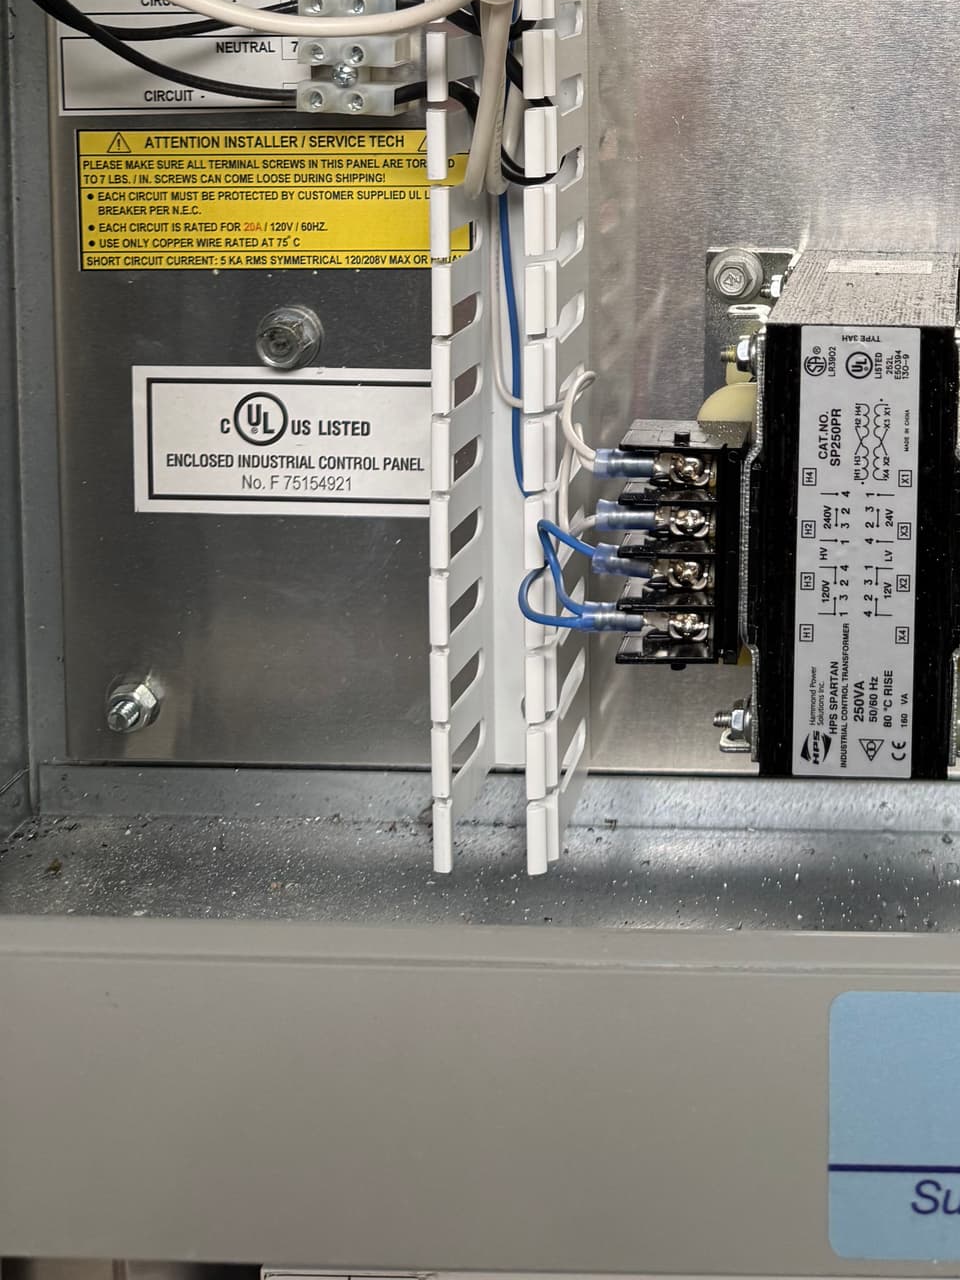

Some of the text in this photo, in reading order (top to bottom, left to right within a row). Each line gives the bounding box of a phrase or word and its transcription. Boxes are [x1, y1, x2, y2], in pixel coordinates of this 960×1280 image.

[216, 42, 275, 53] NEUTRAL
[144, 90, 194, 102] CIRCUIT
[144, 135, 405, 149] ATTENTION INSTALLER SERVICE TECH
[83, 159, 403, 170] PLEASE MAKE SURE ALL TERMINAL SCREWS THIS PANEL ARE
[108, 173, 386, 184] LBS. SCREWS CAN COME LOOSE DURING SHIPPING!
[98, 192, 125, 201] EACH
[128, 192, 168, 201] CIRCUIT
[171, 191, 199, 201] MUST
[218, 191, 279, 200] PROTECTED
[281, 191, 295, 200] BY
[297, 190, 353, 200] CUSTOMER
[357, 190, 406, 200] SUPPLIED
[409, 190, 422, 199] UL
[98, 206, 202, 215] BREAKER PER N.E.C.
[99, 222, 328, 232] EACH CIRCUIT RATED FOR 20A 120V 60HZ.
[100, 238, 275, 248] USE ONLY COPPER WIRE RATED AT
[86, 257, 121, 266] SHORT
[124, 257, 164, 266] CIRCUIT
[166, 257, 219, 266] CURRENT:
[229, 256, 242, 265] KA
[245, 256, 267, 265] RMS
[270, 255, 342, 265] SYMMETRICAL
[345, 255, 387, 265] 120/208V
[389, 255, 411, 264] MAX
[413, 255, 428, 264] OR
[828, 346, 836, 377] LR3902
[220, 403, 371, 437] C UL US LISTED
[818, 411, 829, 460] CAT.NO.
[830, 408, 842, 466] SP250PR
[166, 453, 425, 472] ENCLOSED INDUSTRIAL CONTROL PANEL
[242, 475, 352, 491] No. F 75154921
[823, 506, 832, 529] 240V
[885, 509, 894, 527] 24V
[822, 580, 830, 603] 120V
[884, 582, 892, 599] 12V
[809, 689, 817, 726] Hammond
[829, 661, 838, 734] HPS SPARTAN
[854, 681, 865, 722] 250VA
[869, 676, 878, 723] 50/60 Hz
[884, 670, 893, 727] 80 RISE
[812, 730, 820, 765] HPS
[840, 723, 848, 768] INDUSTRIAL
[892, 740, 906, 761] CE
